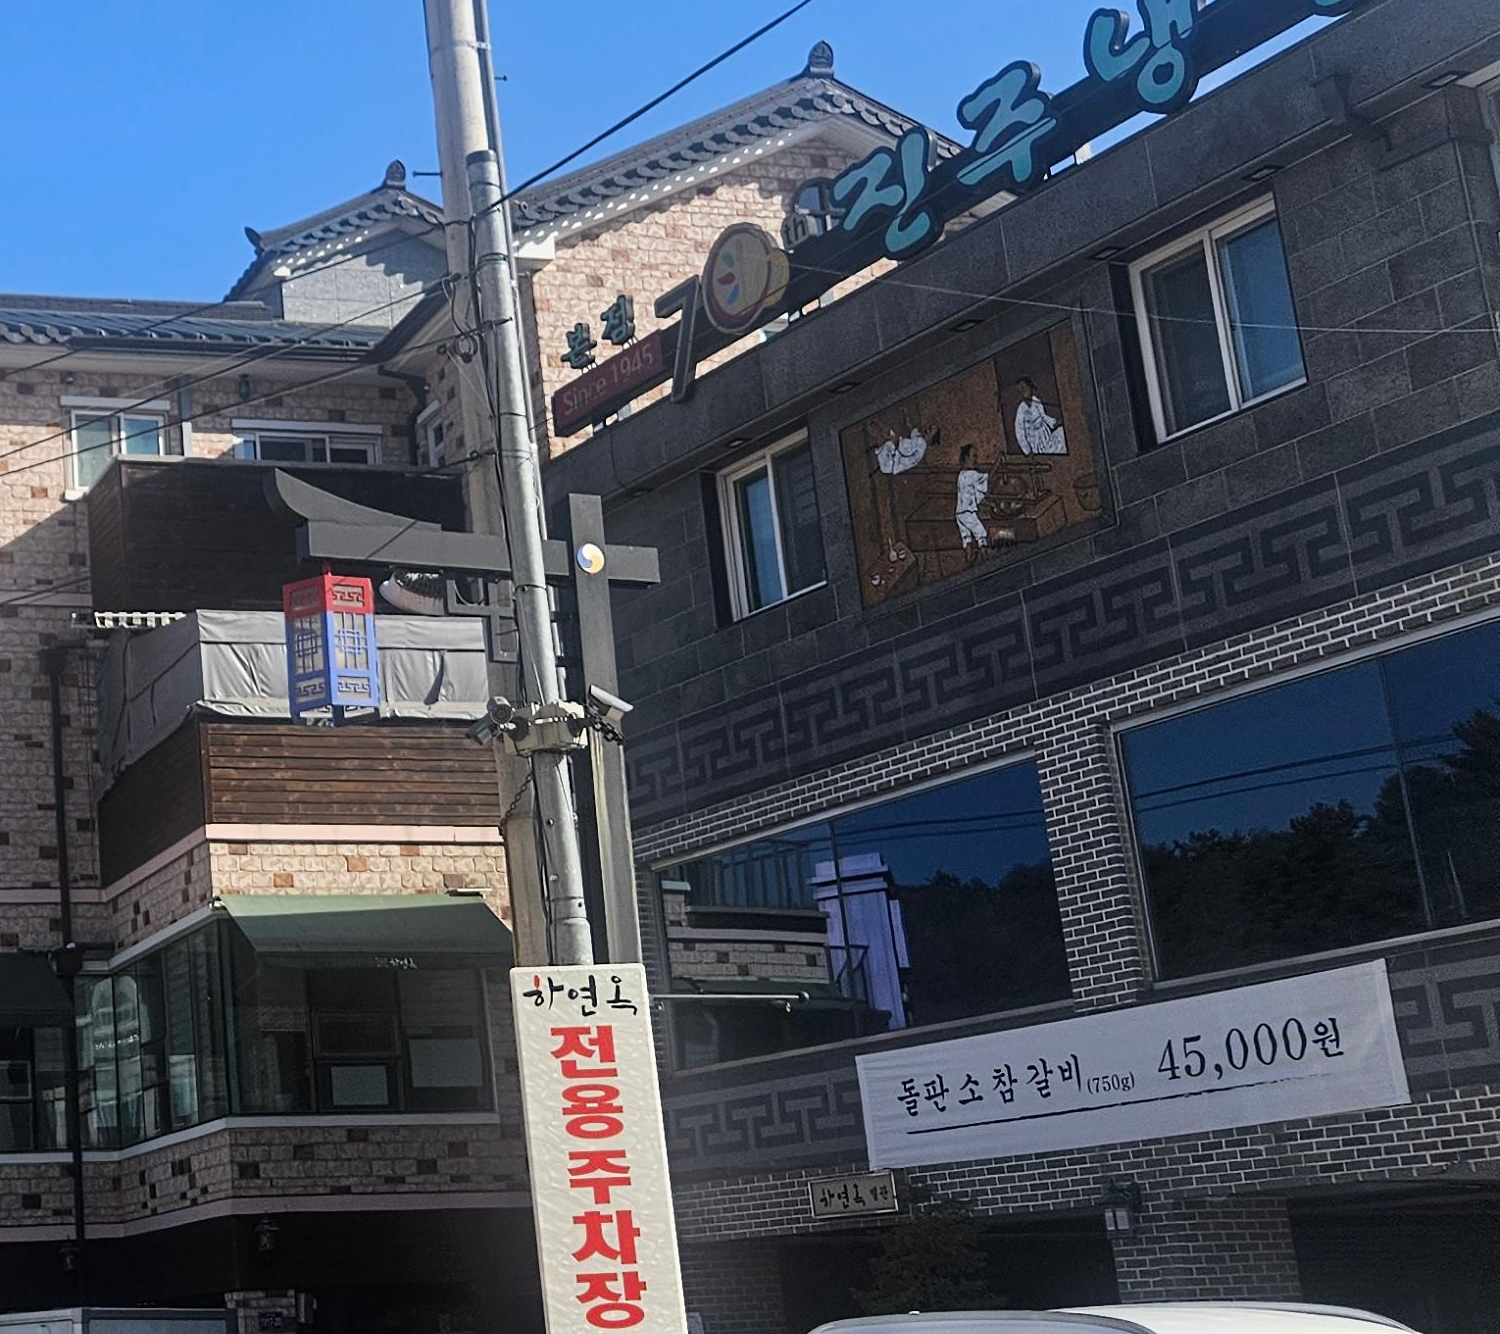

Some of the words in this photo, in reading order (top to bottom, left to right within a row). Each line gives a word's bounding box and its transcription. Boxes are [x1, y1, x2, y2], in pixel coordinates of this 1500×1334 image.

[563, 295, 634, 369] 본점
[563, 376, 606, 415] Since
[611, 350, 654, 389] 1945
[522, 975, 638, 1017] 하연옥
[896, 1074, 951, 1118] 돌판
[1086, 1070, 1136, 1096] (750g)
[1157, 1016, 1346, 1082] 45,000원
[819, 1182, 867, 1210] 하연옥
